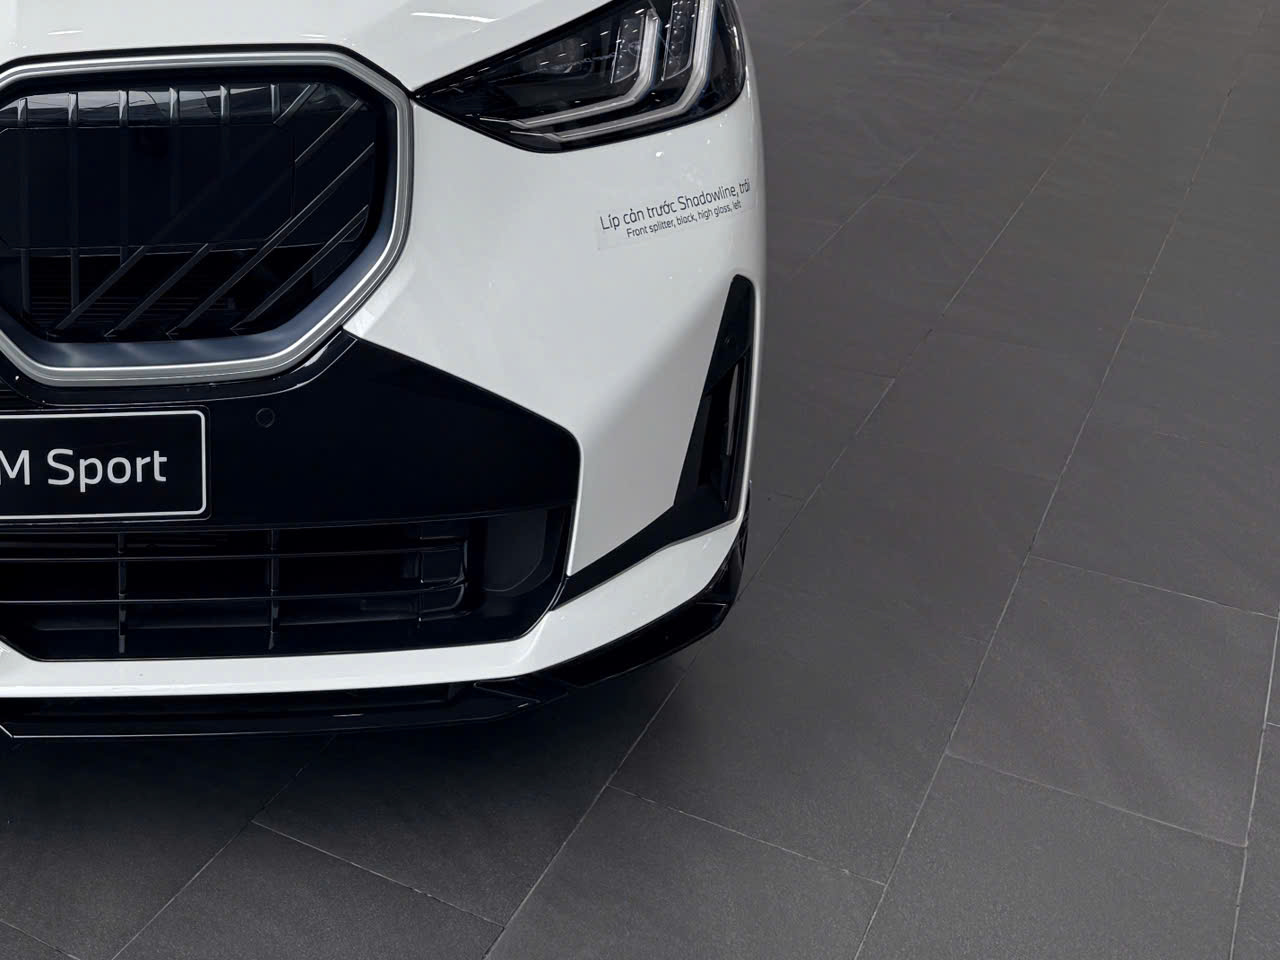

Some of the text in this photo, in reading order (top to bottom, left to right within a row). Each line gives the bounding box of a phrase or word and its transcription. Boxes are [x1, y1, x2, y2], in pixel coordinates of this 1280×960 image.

[646, 200, 677, 219] trước
[677, 186, 739, 211] Shadowline,
[626, 226, 648, 238] Front
[649, 219, 676, 234] splitter,
[676, 212, 697, 226] black,
[697, 208, 713, 220] high
[714, 204, 733, 218] gloss,
[47, 448, 168, 493] Sport
